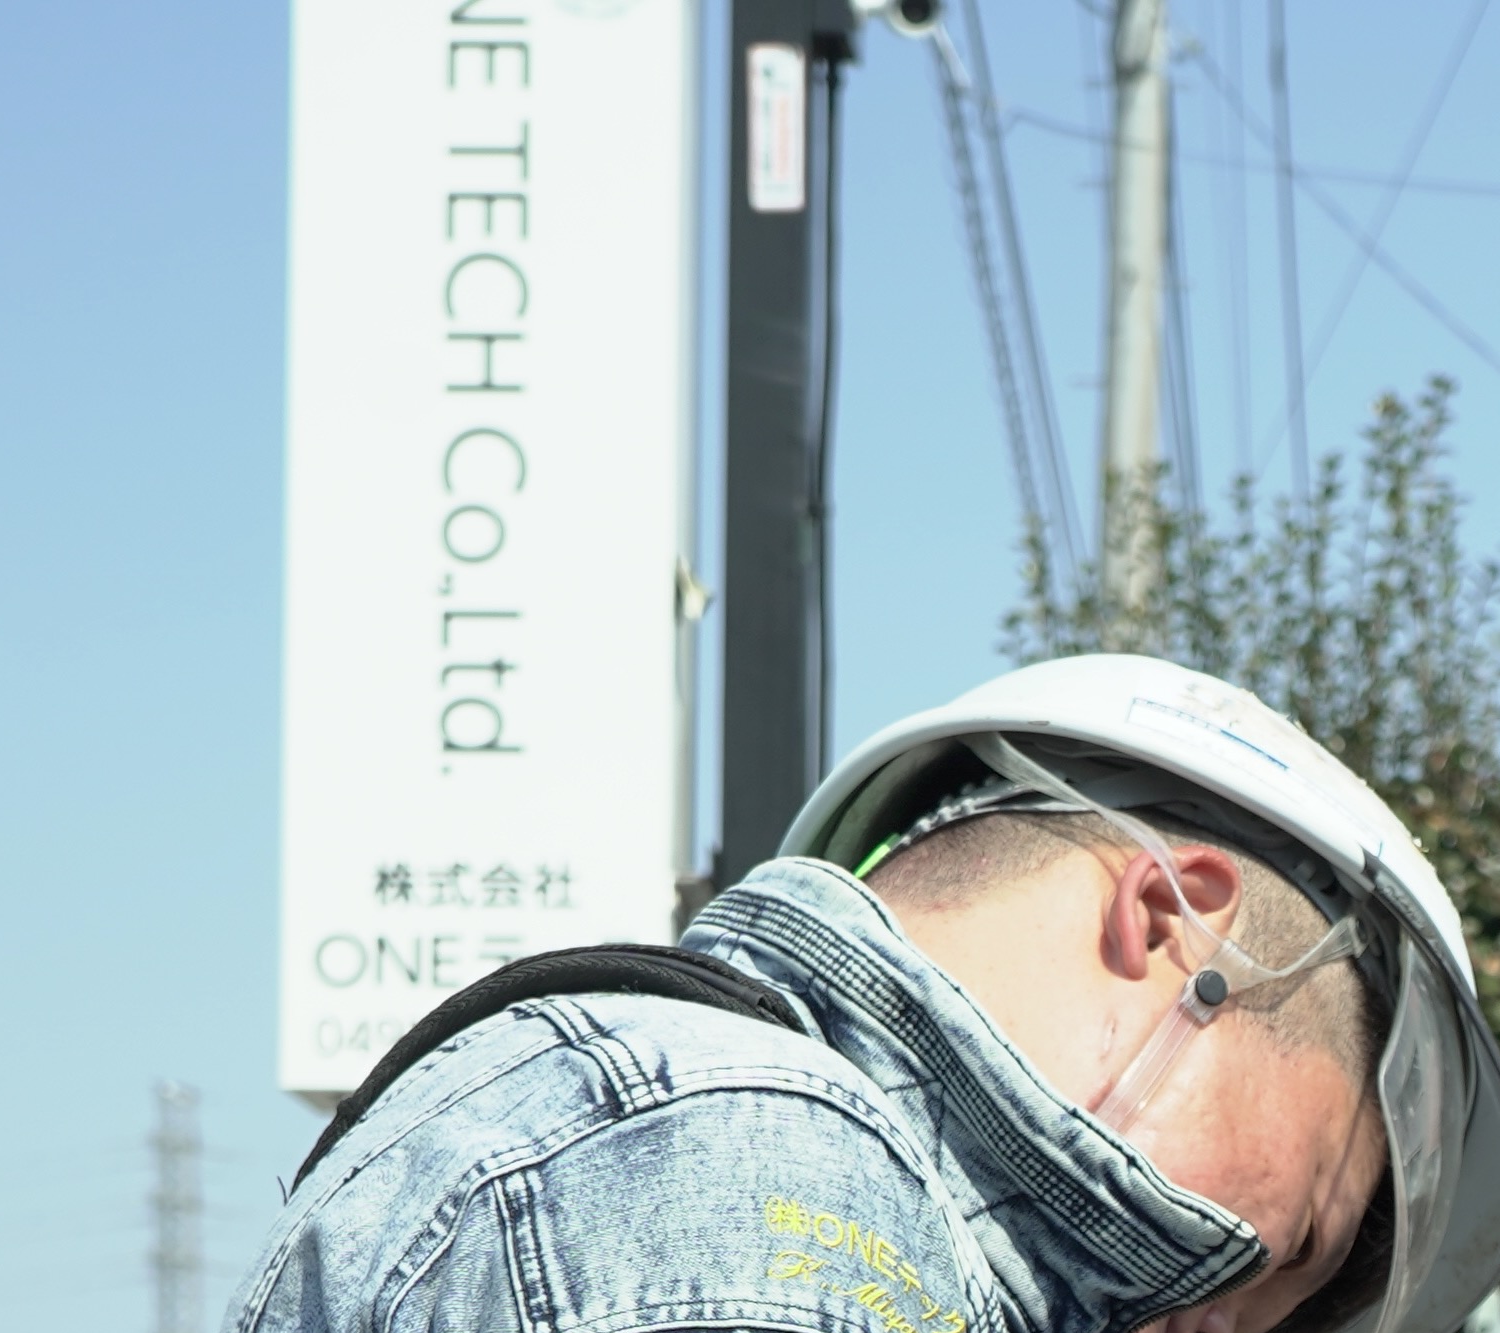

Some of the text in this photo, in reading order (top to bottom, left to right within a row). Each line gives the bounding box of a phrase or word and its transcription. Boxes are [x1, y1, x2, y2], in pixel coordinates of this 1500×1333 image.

[446, 120, 531, 393] TECH
[373, 861, 576, 908] 株式会社
